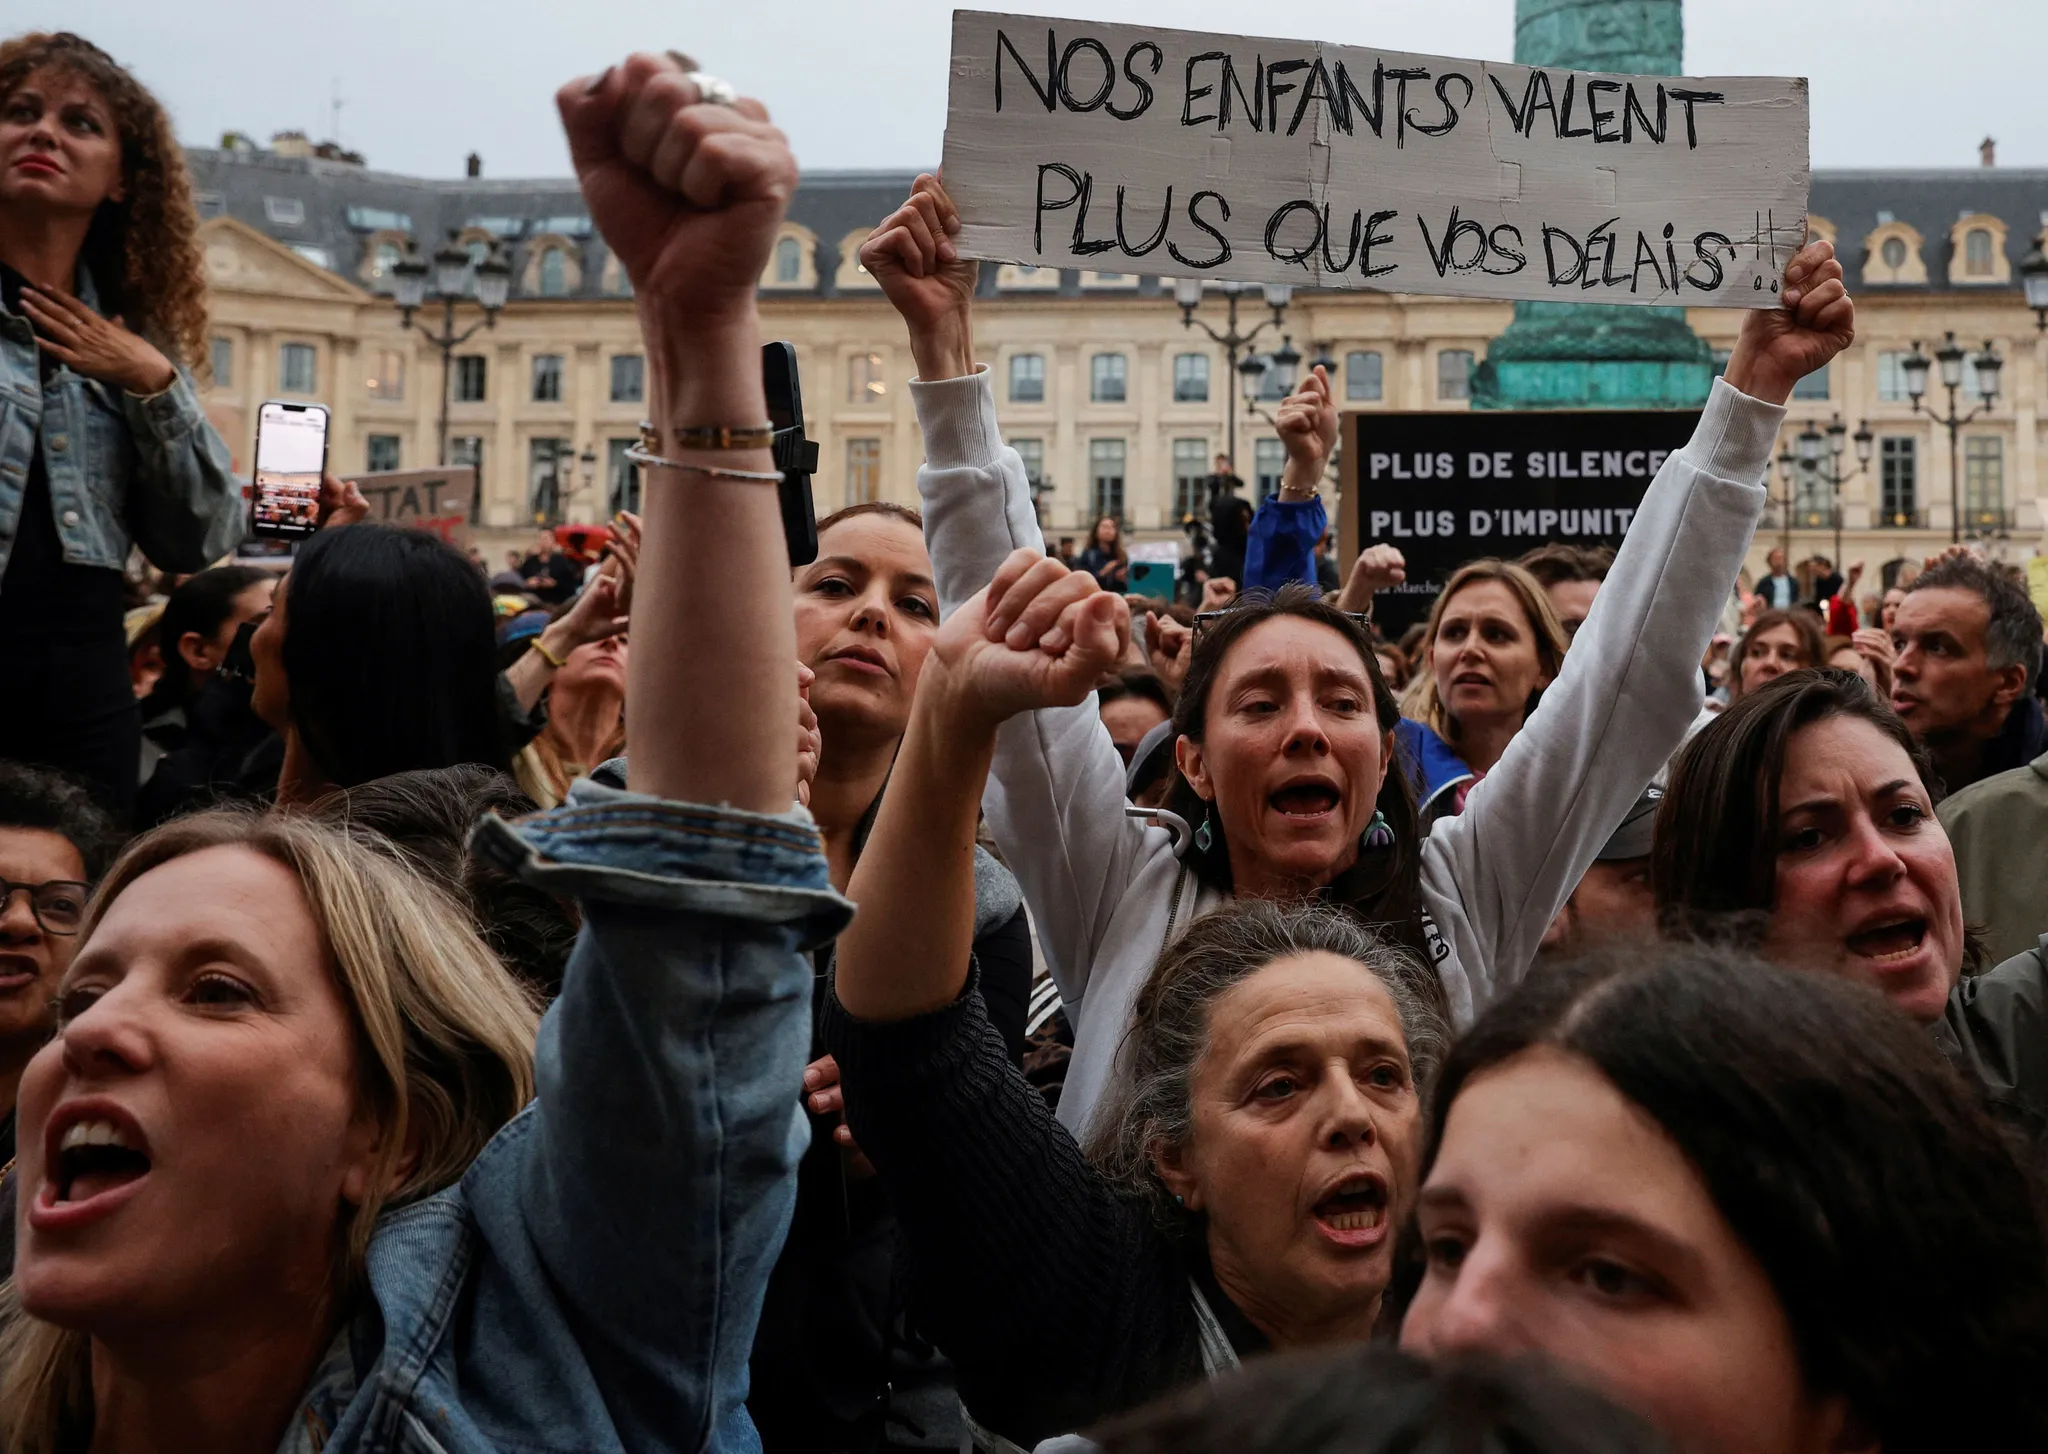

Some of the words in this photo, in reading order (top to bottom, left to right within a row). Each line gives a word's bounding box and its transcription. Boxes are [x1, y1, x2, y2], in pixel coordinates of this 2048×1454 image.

[995, 28, 1163, 120] NOS
[1180, 52, 1473, 149] ENFANTS
[1488, 70, 1725, 150] VALENT
[1033, 162, 1232, 269] PLUS
[1264, 200, 1398, 278] QUE
[1417, 205, 1526, 278] VOS
[1370, 453, 1455, 479] PLUS
[1468, 452, 1513, 478] DE
[1527, 450, 1668, 478] SILENCE
[360, 480, 448, 519] TAT
[1371, 510, 1455, 537] PLUS
[1469, 508, 1635, 537] D'IMPUNIT
